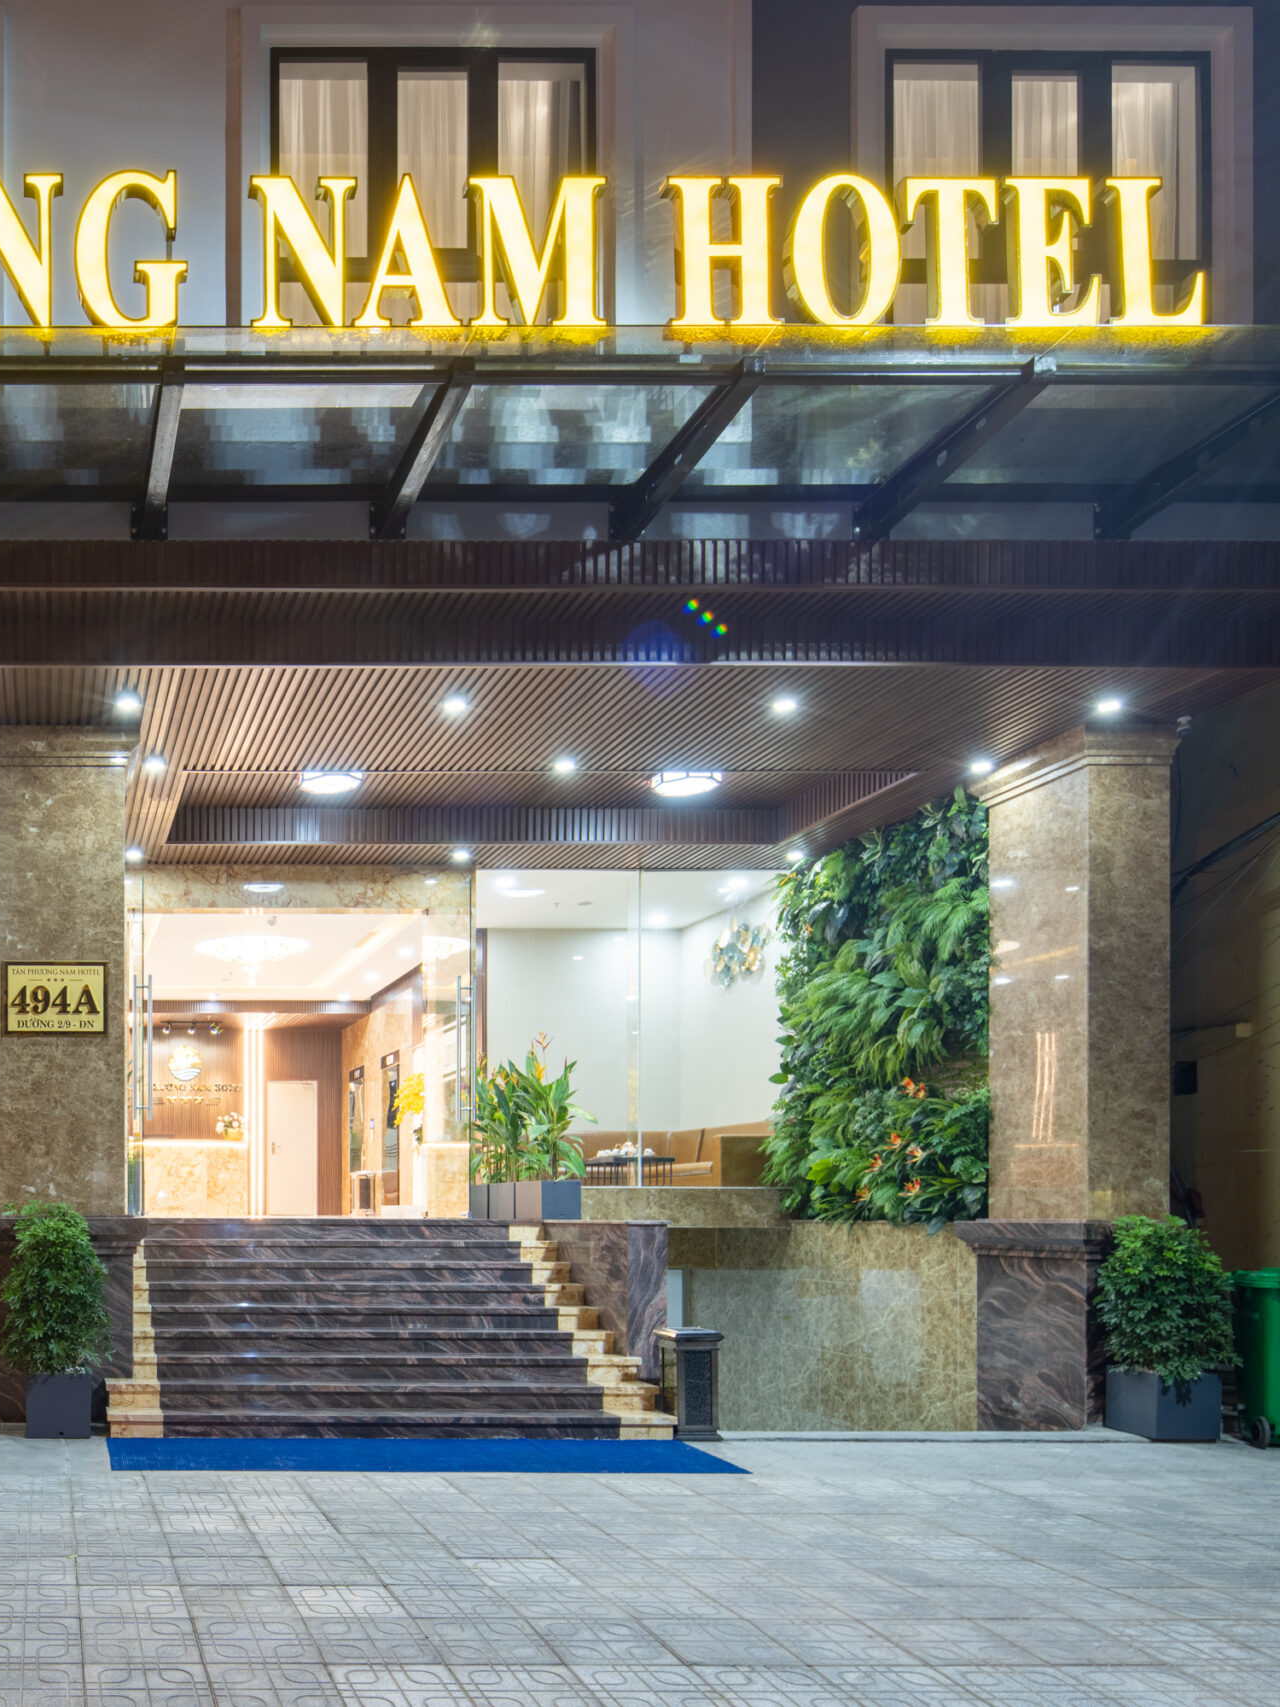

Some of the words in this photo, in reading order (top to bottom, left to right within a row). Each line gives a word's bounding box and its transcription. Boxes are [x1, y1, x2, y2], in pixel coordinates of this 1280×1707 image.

[249, 172, 608, 328] NAM
[662, 172, 1207, 328] HOTEL
[59, 968, 76, 976] NAM
[77, 968, 100, 976] HOTEL
[9, 984, 100, 1015] 494A
[17, 1017, 55, 1029] ĐƯỜNG
[57, 1019, 71, 1029] 2/9
